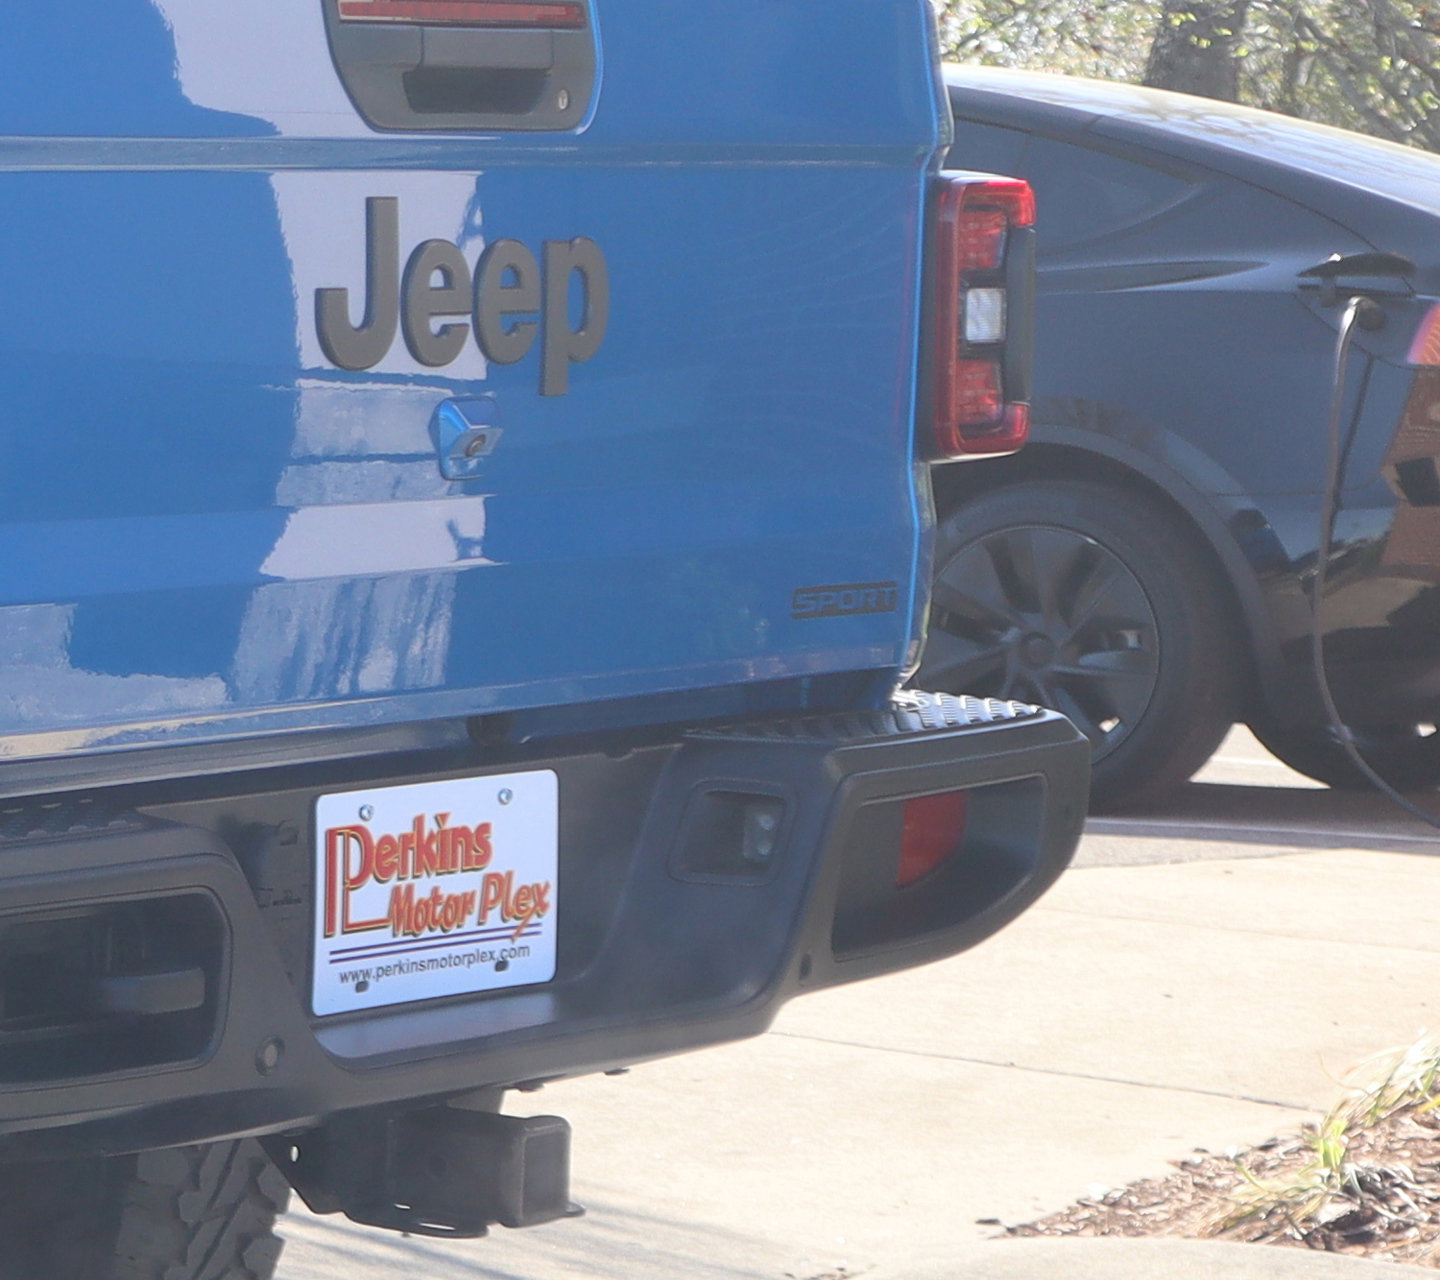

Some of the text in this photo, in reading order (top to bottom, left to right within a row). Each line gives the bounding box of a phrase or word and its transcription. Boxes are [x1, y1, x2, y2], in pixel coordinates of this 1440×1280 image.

[315, 196, 610, 397] Jeep
[791, 586, 897, 616] SPORT
[324, 812, 493, 937] Perkins
[338, 943, 531, 985] www.perkinsmotorplex.com
